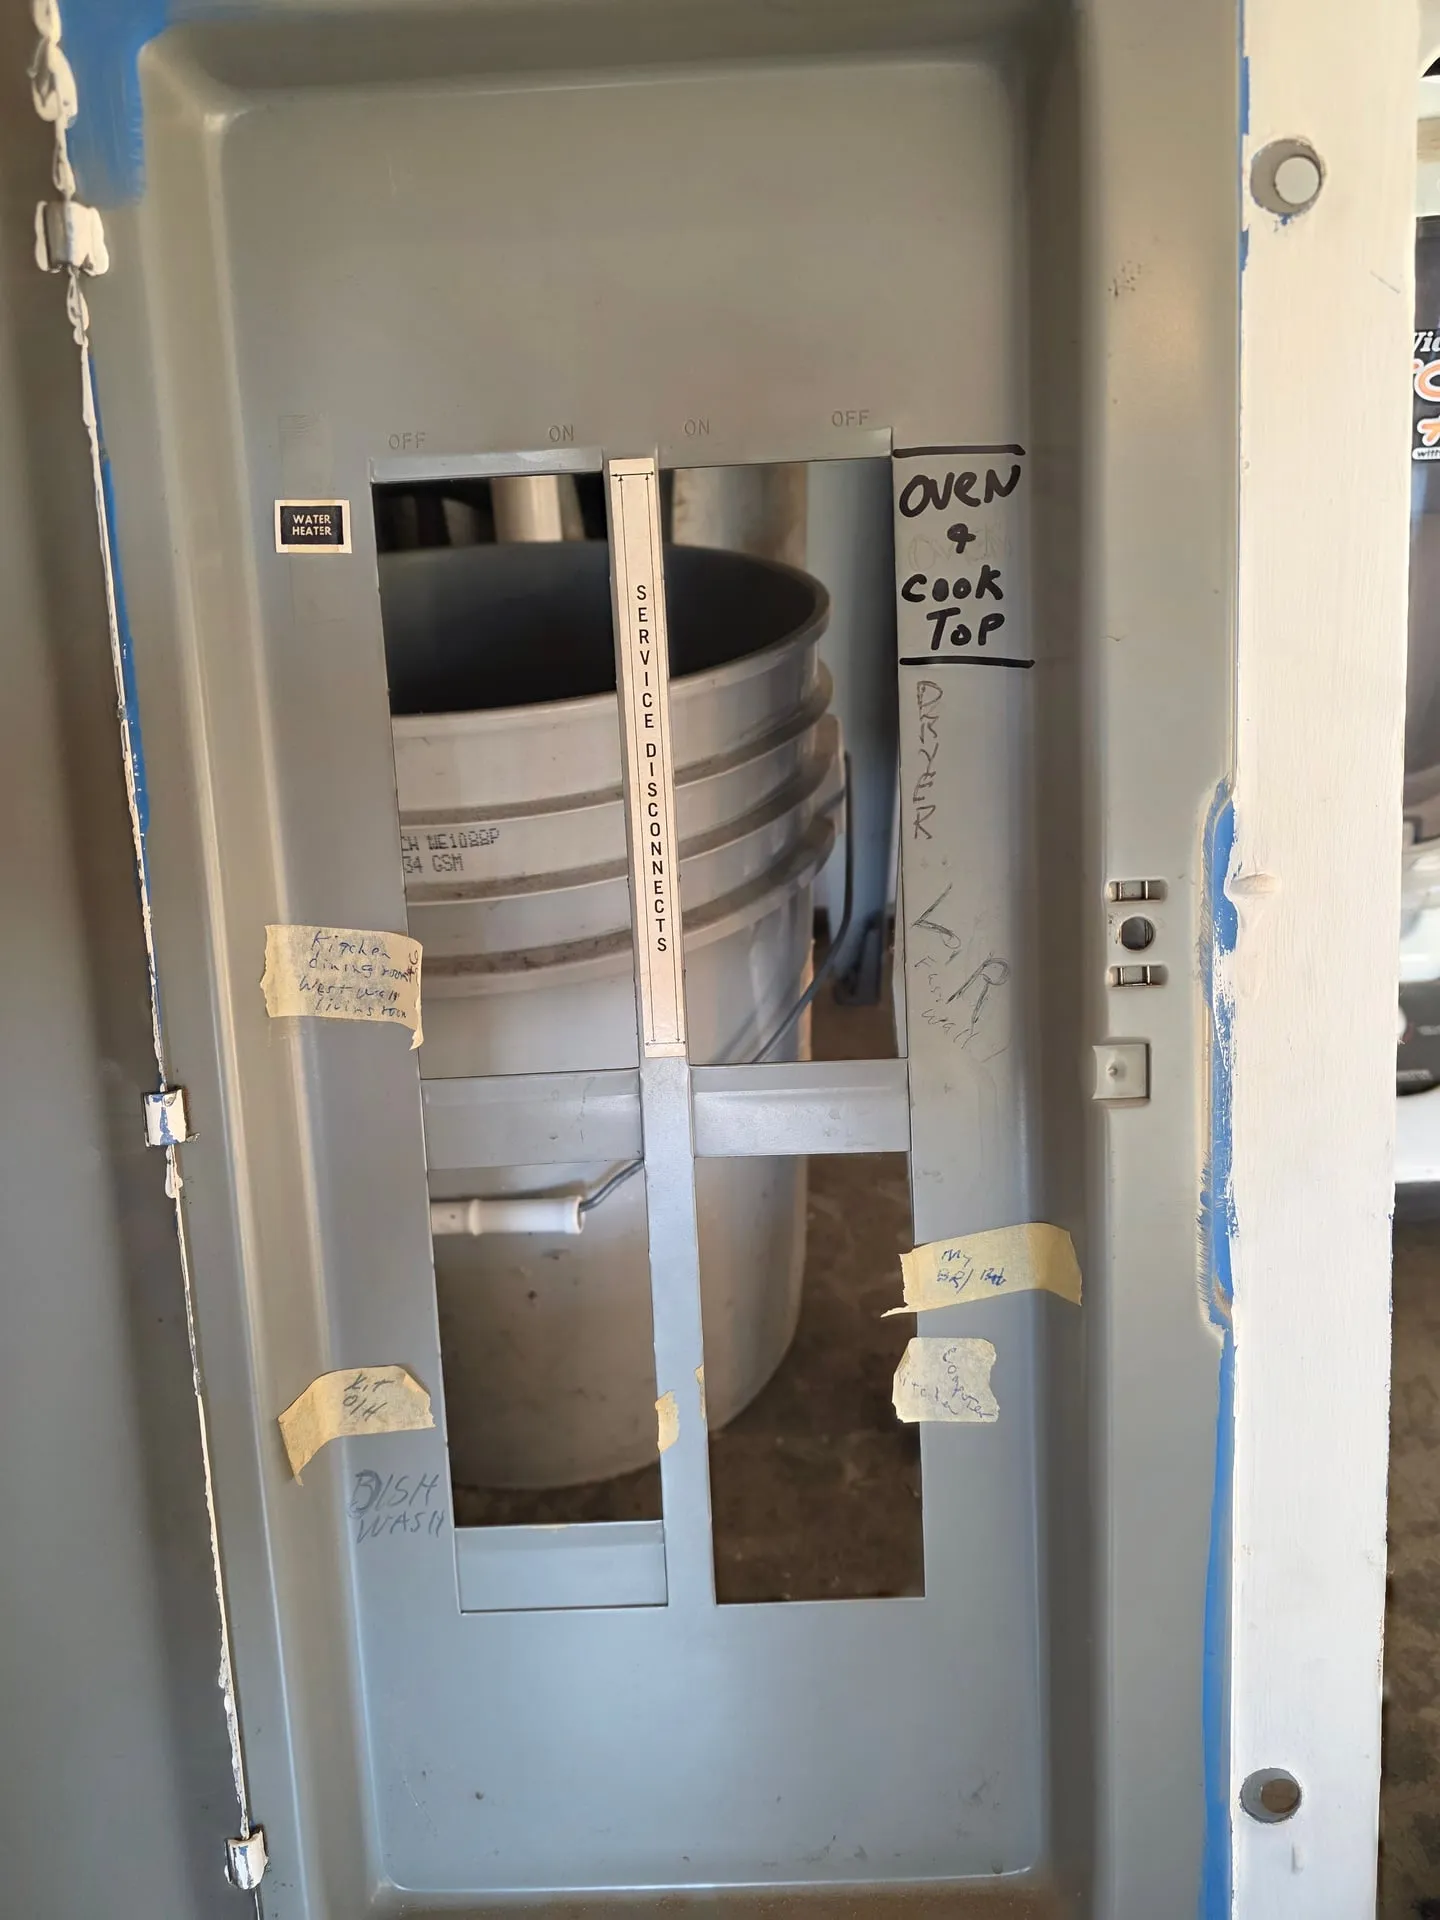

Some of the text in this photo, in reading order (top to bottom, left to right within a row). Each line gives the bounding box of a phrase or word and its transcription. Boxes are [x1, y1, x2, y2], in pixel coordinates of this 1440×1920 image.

[684, 418, 712, 438] ON
[831, 409, 871, 429] OFF
[387, 430, 427, 450] OFF
[548, 424, 575, 444] ON
[292, 514, 332, 524] WATER
[292, 526, 332, 536] HEATER
[636, 584, 668, 953] SERVICE DISCONNECTS
[912, 680, 944, 840] DRYER
[431, 853, 465, 873] GSM
[356, 1509, 446, 1544] WASH
